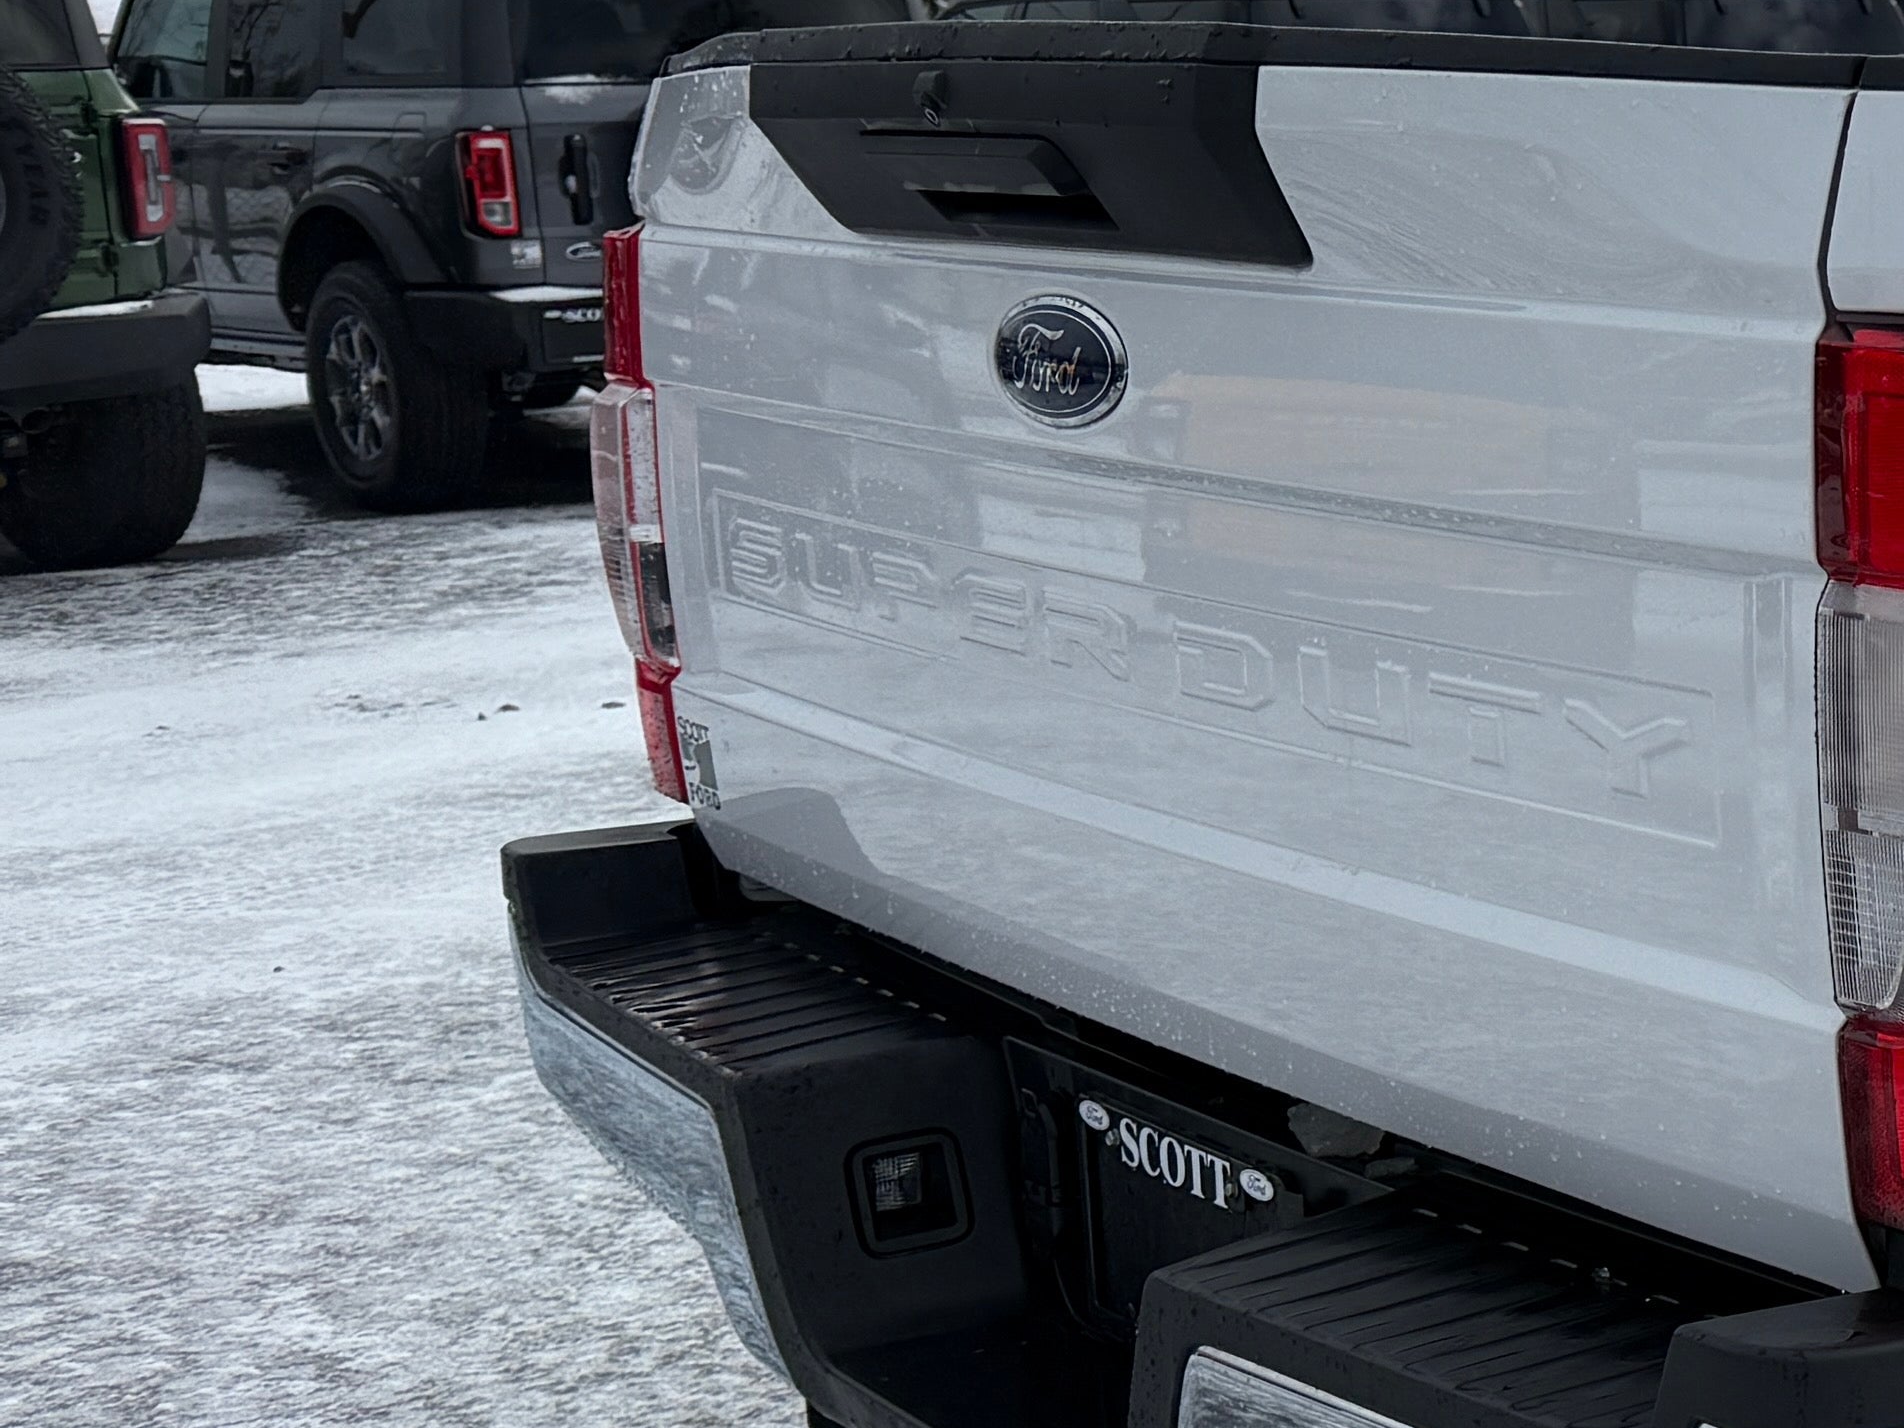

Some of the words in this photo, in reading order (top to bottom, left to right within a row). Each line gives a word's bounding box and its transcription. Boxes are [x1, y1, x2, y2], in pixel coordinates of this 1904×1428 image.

[560, 307, 604, 324] SCO
[1012, 322, 1082, 396] Ford
[727, 514, 1138, 684] SUPER
[1170, 618, 1692, 800] DUTY
[688, 781, 721, 811] FORD
[1119, 1117, 1231, 1209] SCOTT
